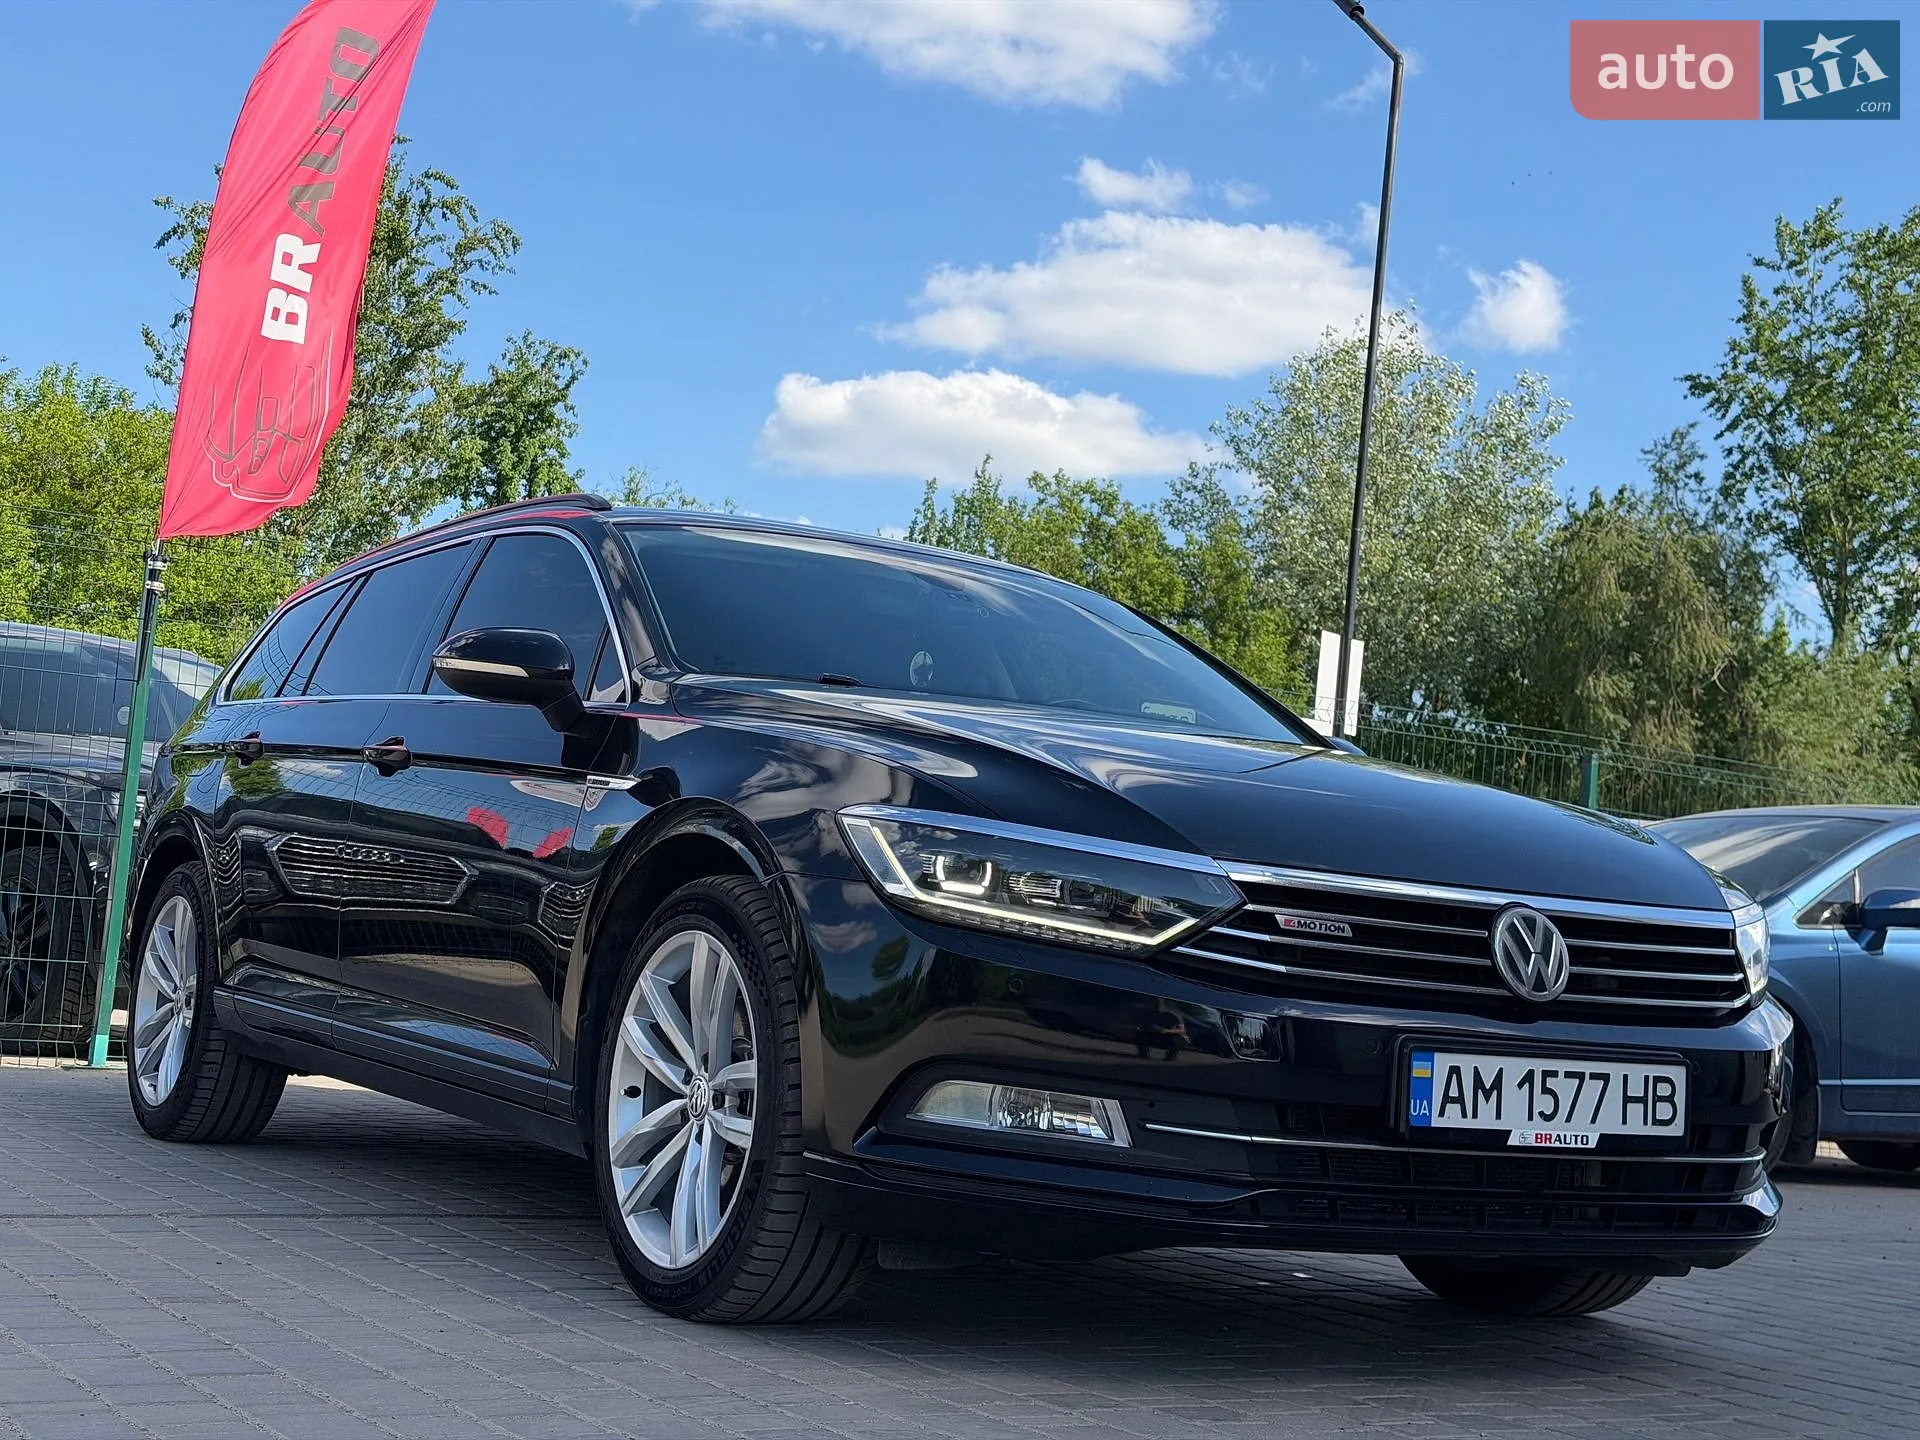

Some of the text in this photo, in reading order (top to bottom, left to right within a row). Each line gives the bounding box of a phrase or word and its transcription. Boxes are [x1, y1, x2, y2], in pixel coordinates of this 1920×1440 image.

[1437, 1064, 1679, 1128] AM 1577 HB
[1410, 1098, 1430, 1117] UA
[1534, 1132, 1590, 1146] BRAUTO
